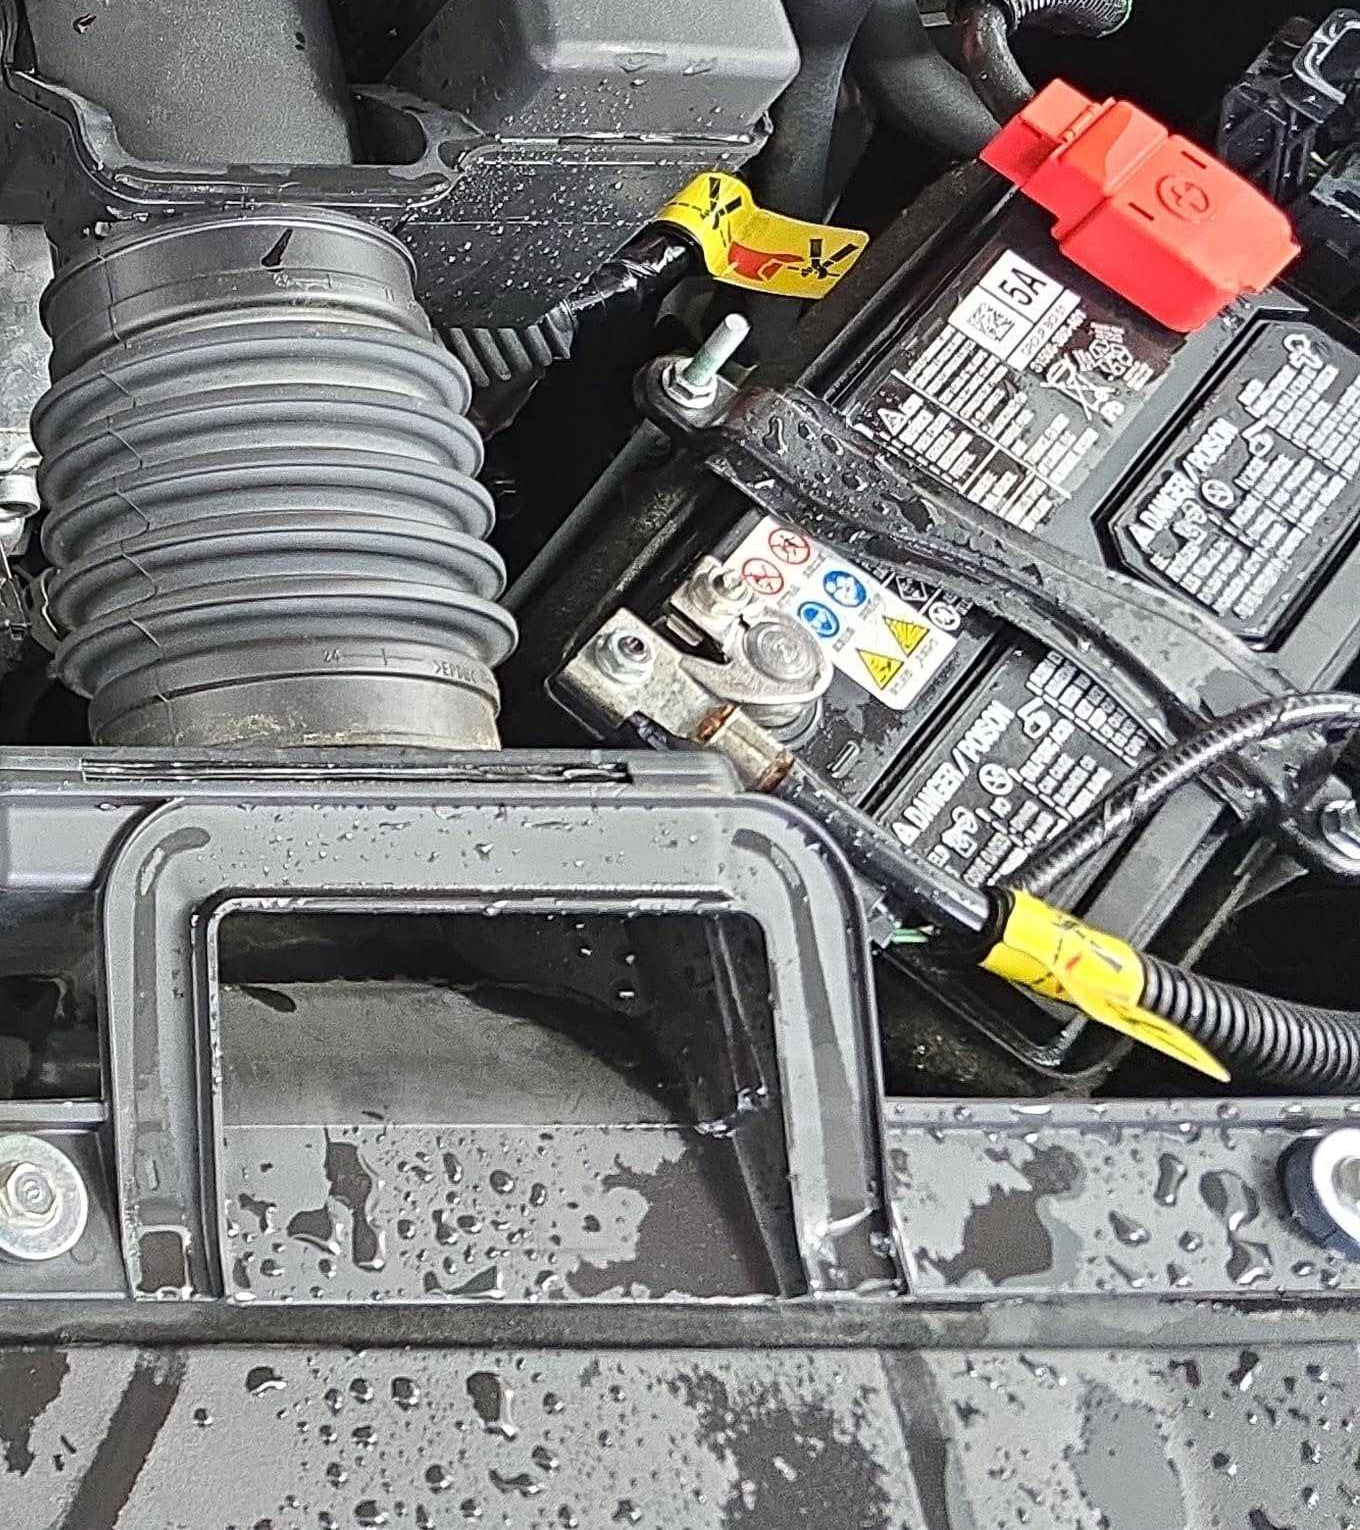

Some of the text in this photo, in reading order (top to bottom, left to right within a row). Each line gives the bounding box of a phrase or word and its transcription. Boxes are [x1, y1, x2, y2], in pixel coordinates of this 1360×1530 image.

[997, 267, 1047, 307] 5A
[1138, 470, 1196, 532] DANGER
[1185, 415, 1239, 473] POISON
[901, 759, 966, 830] DANGER
[955, 698, 1015, 763] POISON
